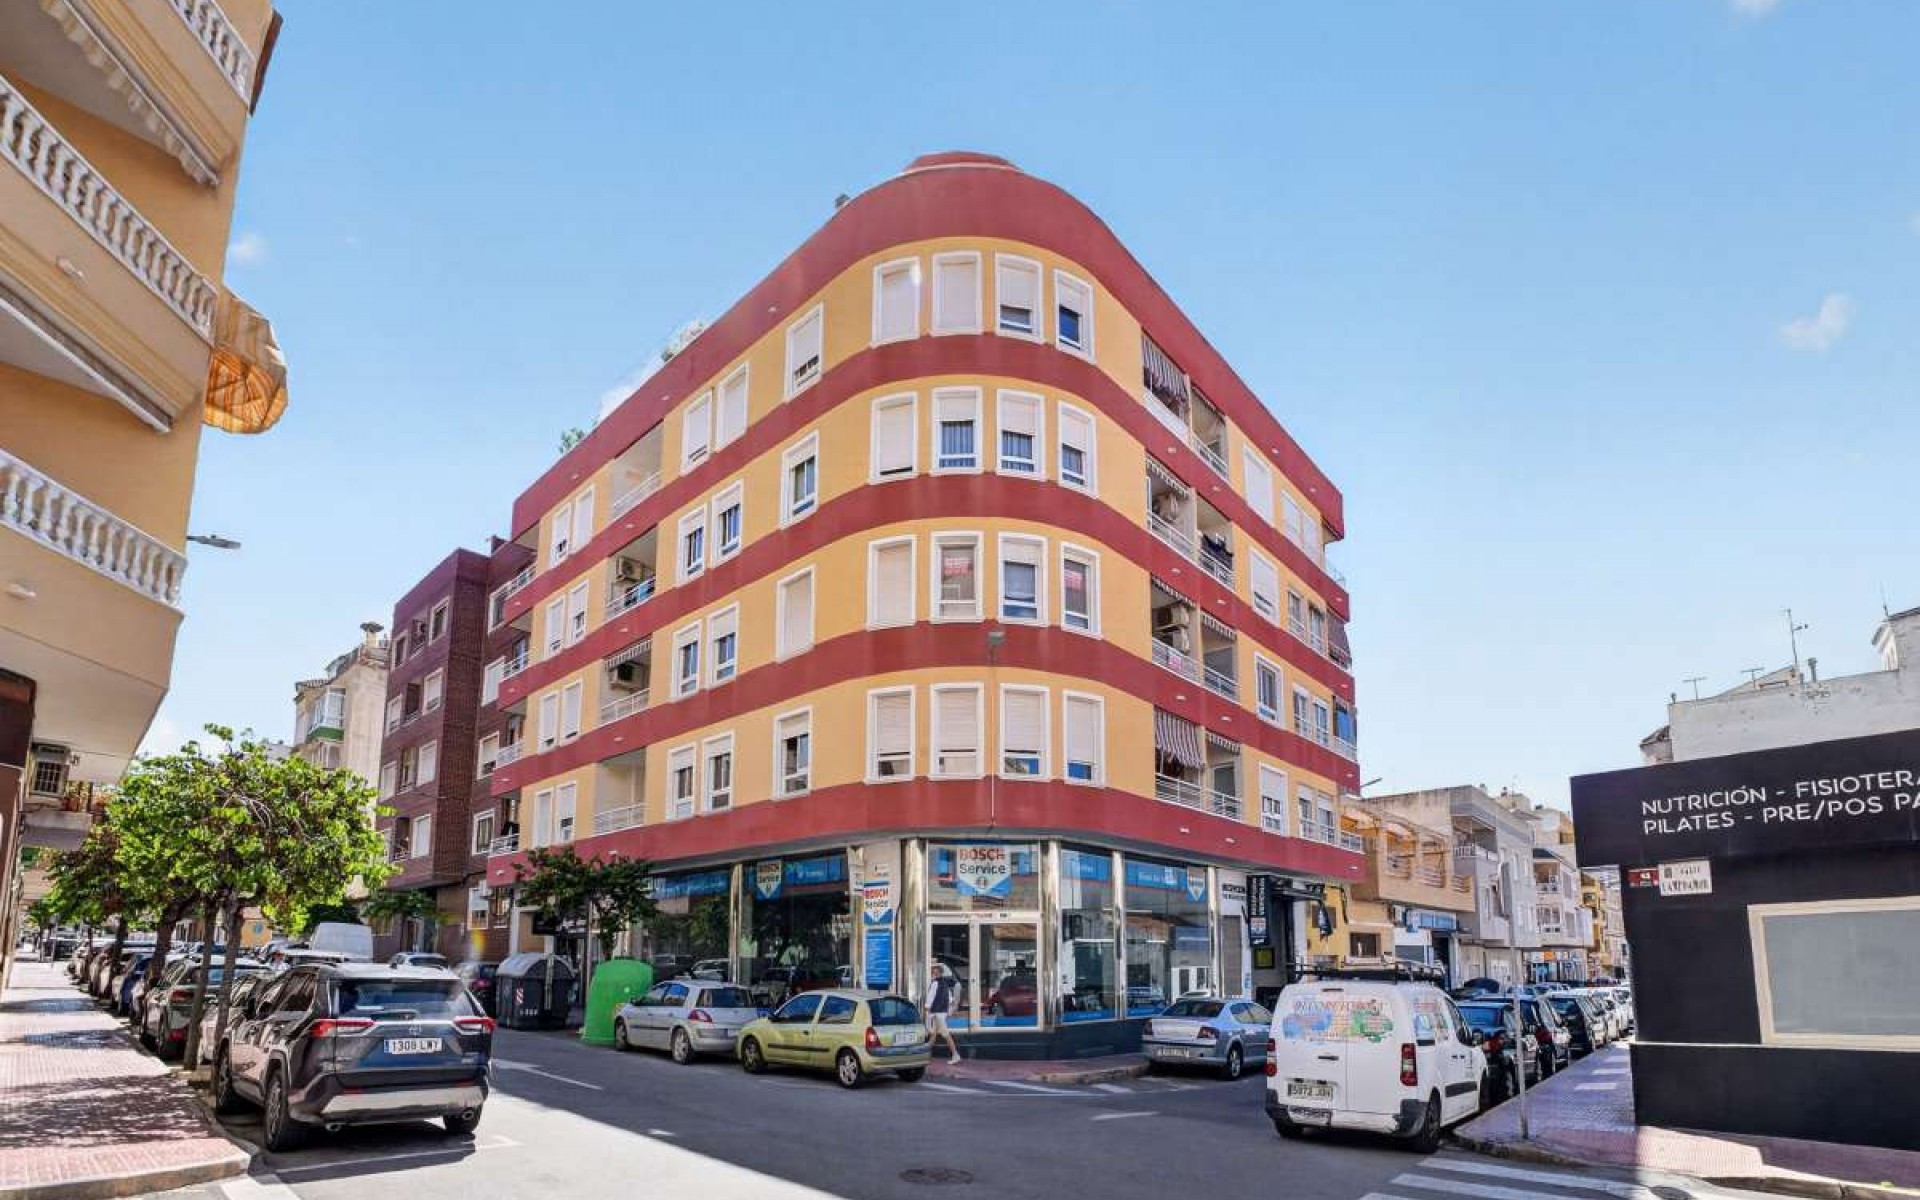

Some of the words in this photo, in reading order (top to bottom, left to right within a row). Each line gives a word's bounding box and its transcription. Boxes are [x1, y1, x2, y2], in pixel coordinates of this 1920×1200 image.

[1641, 785, 1768, 817] NUTRICIÓN
[1794, 770, 1920, 799] FISIOTER
[1643, 810, 1736, 836] PILATES
[1762, 796, 1885, 824] PRE/POS
[959, 847, 1005, 861] BOSCH
[959, 862, 1007, 876] Service
[863, 887, 889, 899] BOSCH
